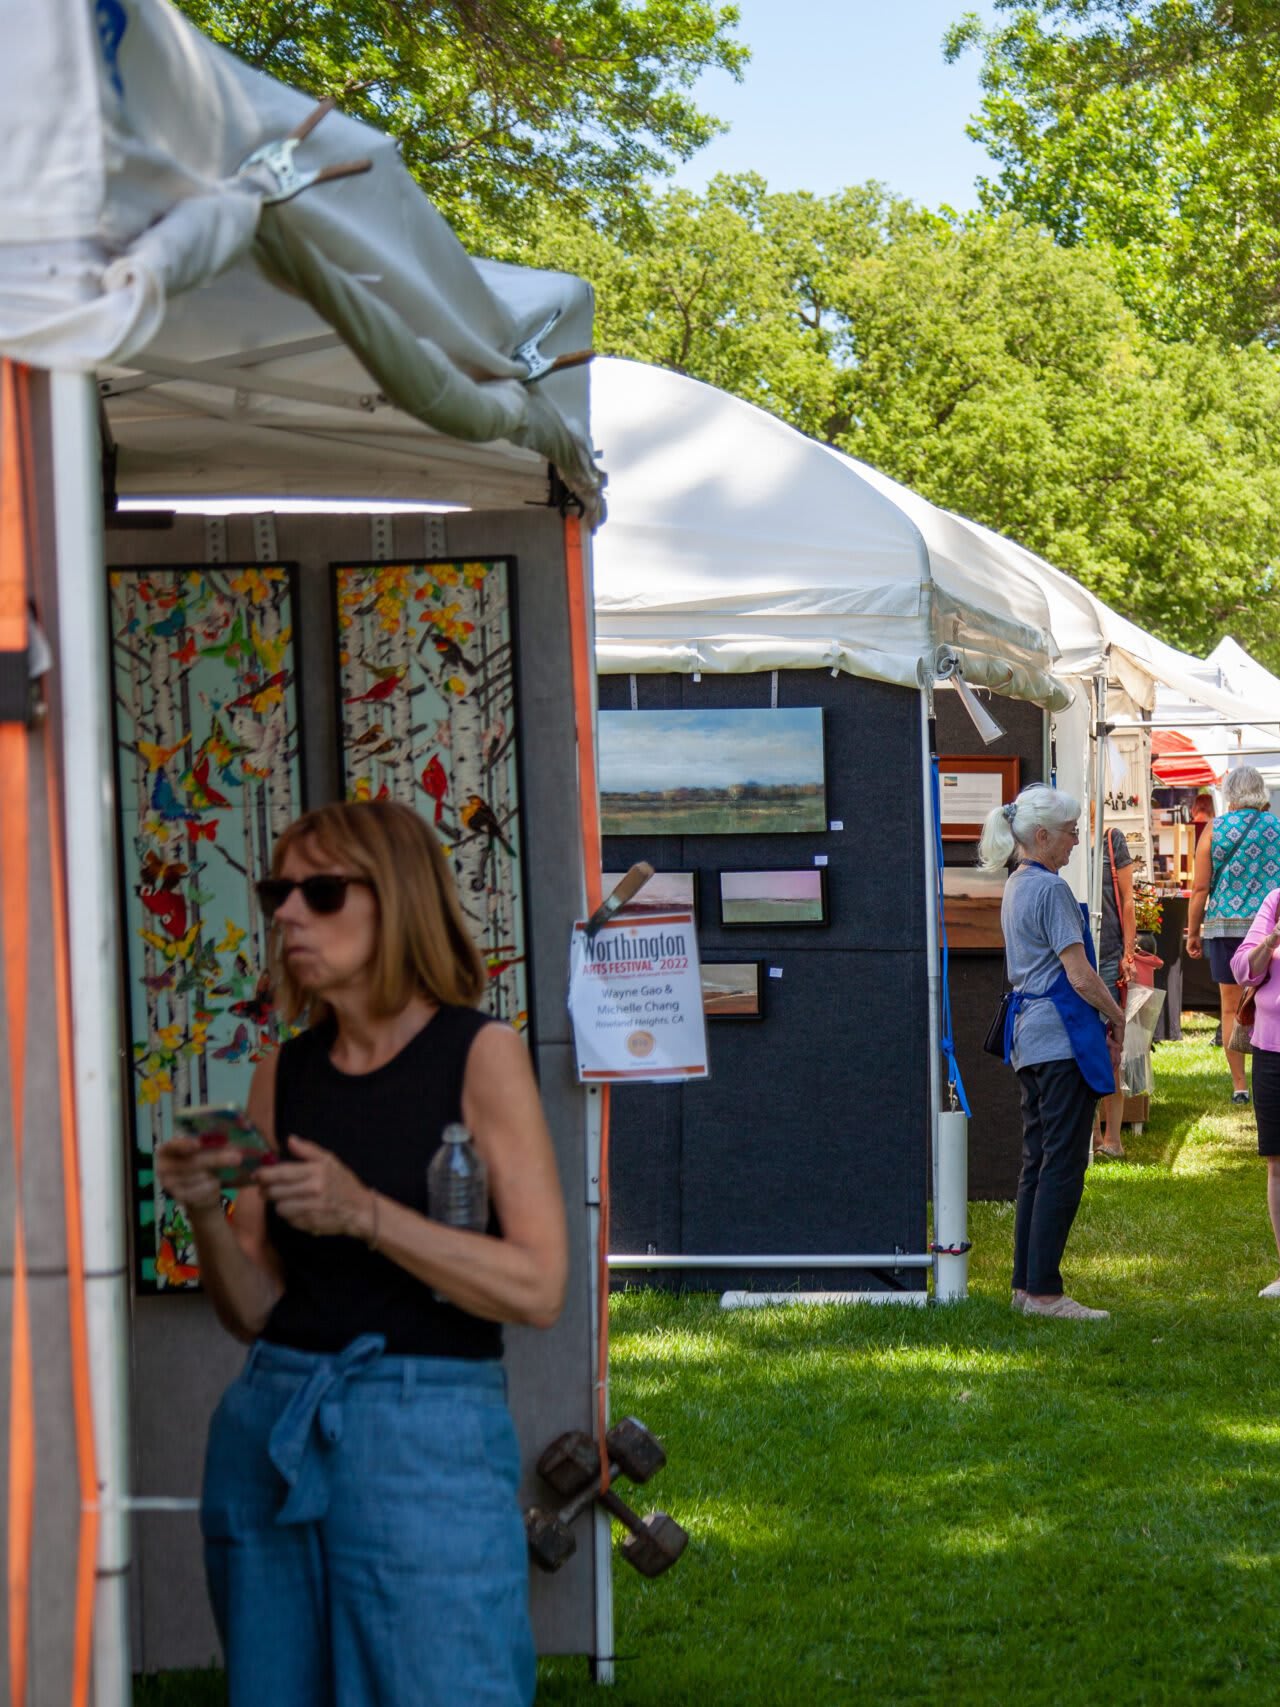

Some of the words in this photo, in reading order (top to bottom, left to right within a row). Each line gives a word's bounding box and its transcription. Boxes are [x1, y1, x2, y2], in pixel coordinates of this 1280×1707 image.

[583, 932, 686, 962] Worthington
[582, 961, 608, 976] ARTS
[609, 959, 654, 974] FESTIVAL
[660, 957, 688, 970] 2022
[601, 987, 638, 1000] Wayne
[641, 985, 662, 996] Gao
[664, 984, 673, 995] &
[597, 1003, 642, 1015] Michelle
[644, 1001, 680, 1013] Chang
[671, 1015, 685, 1024] CA
